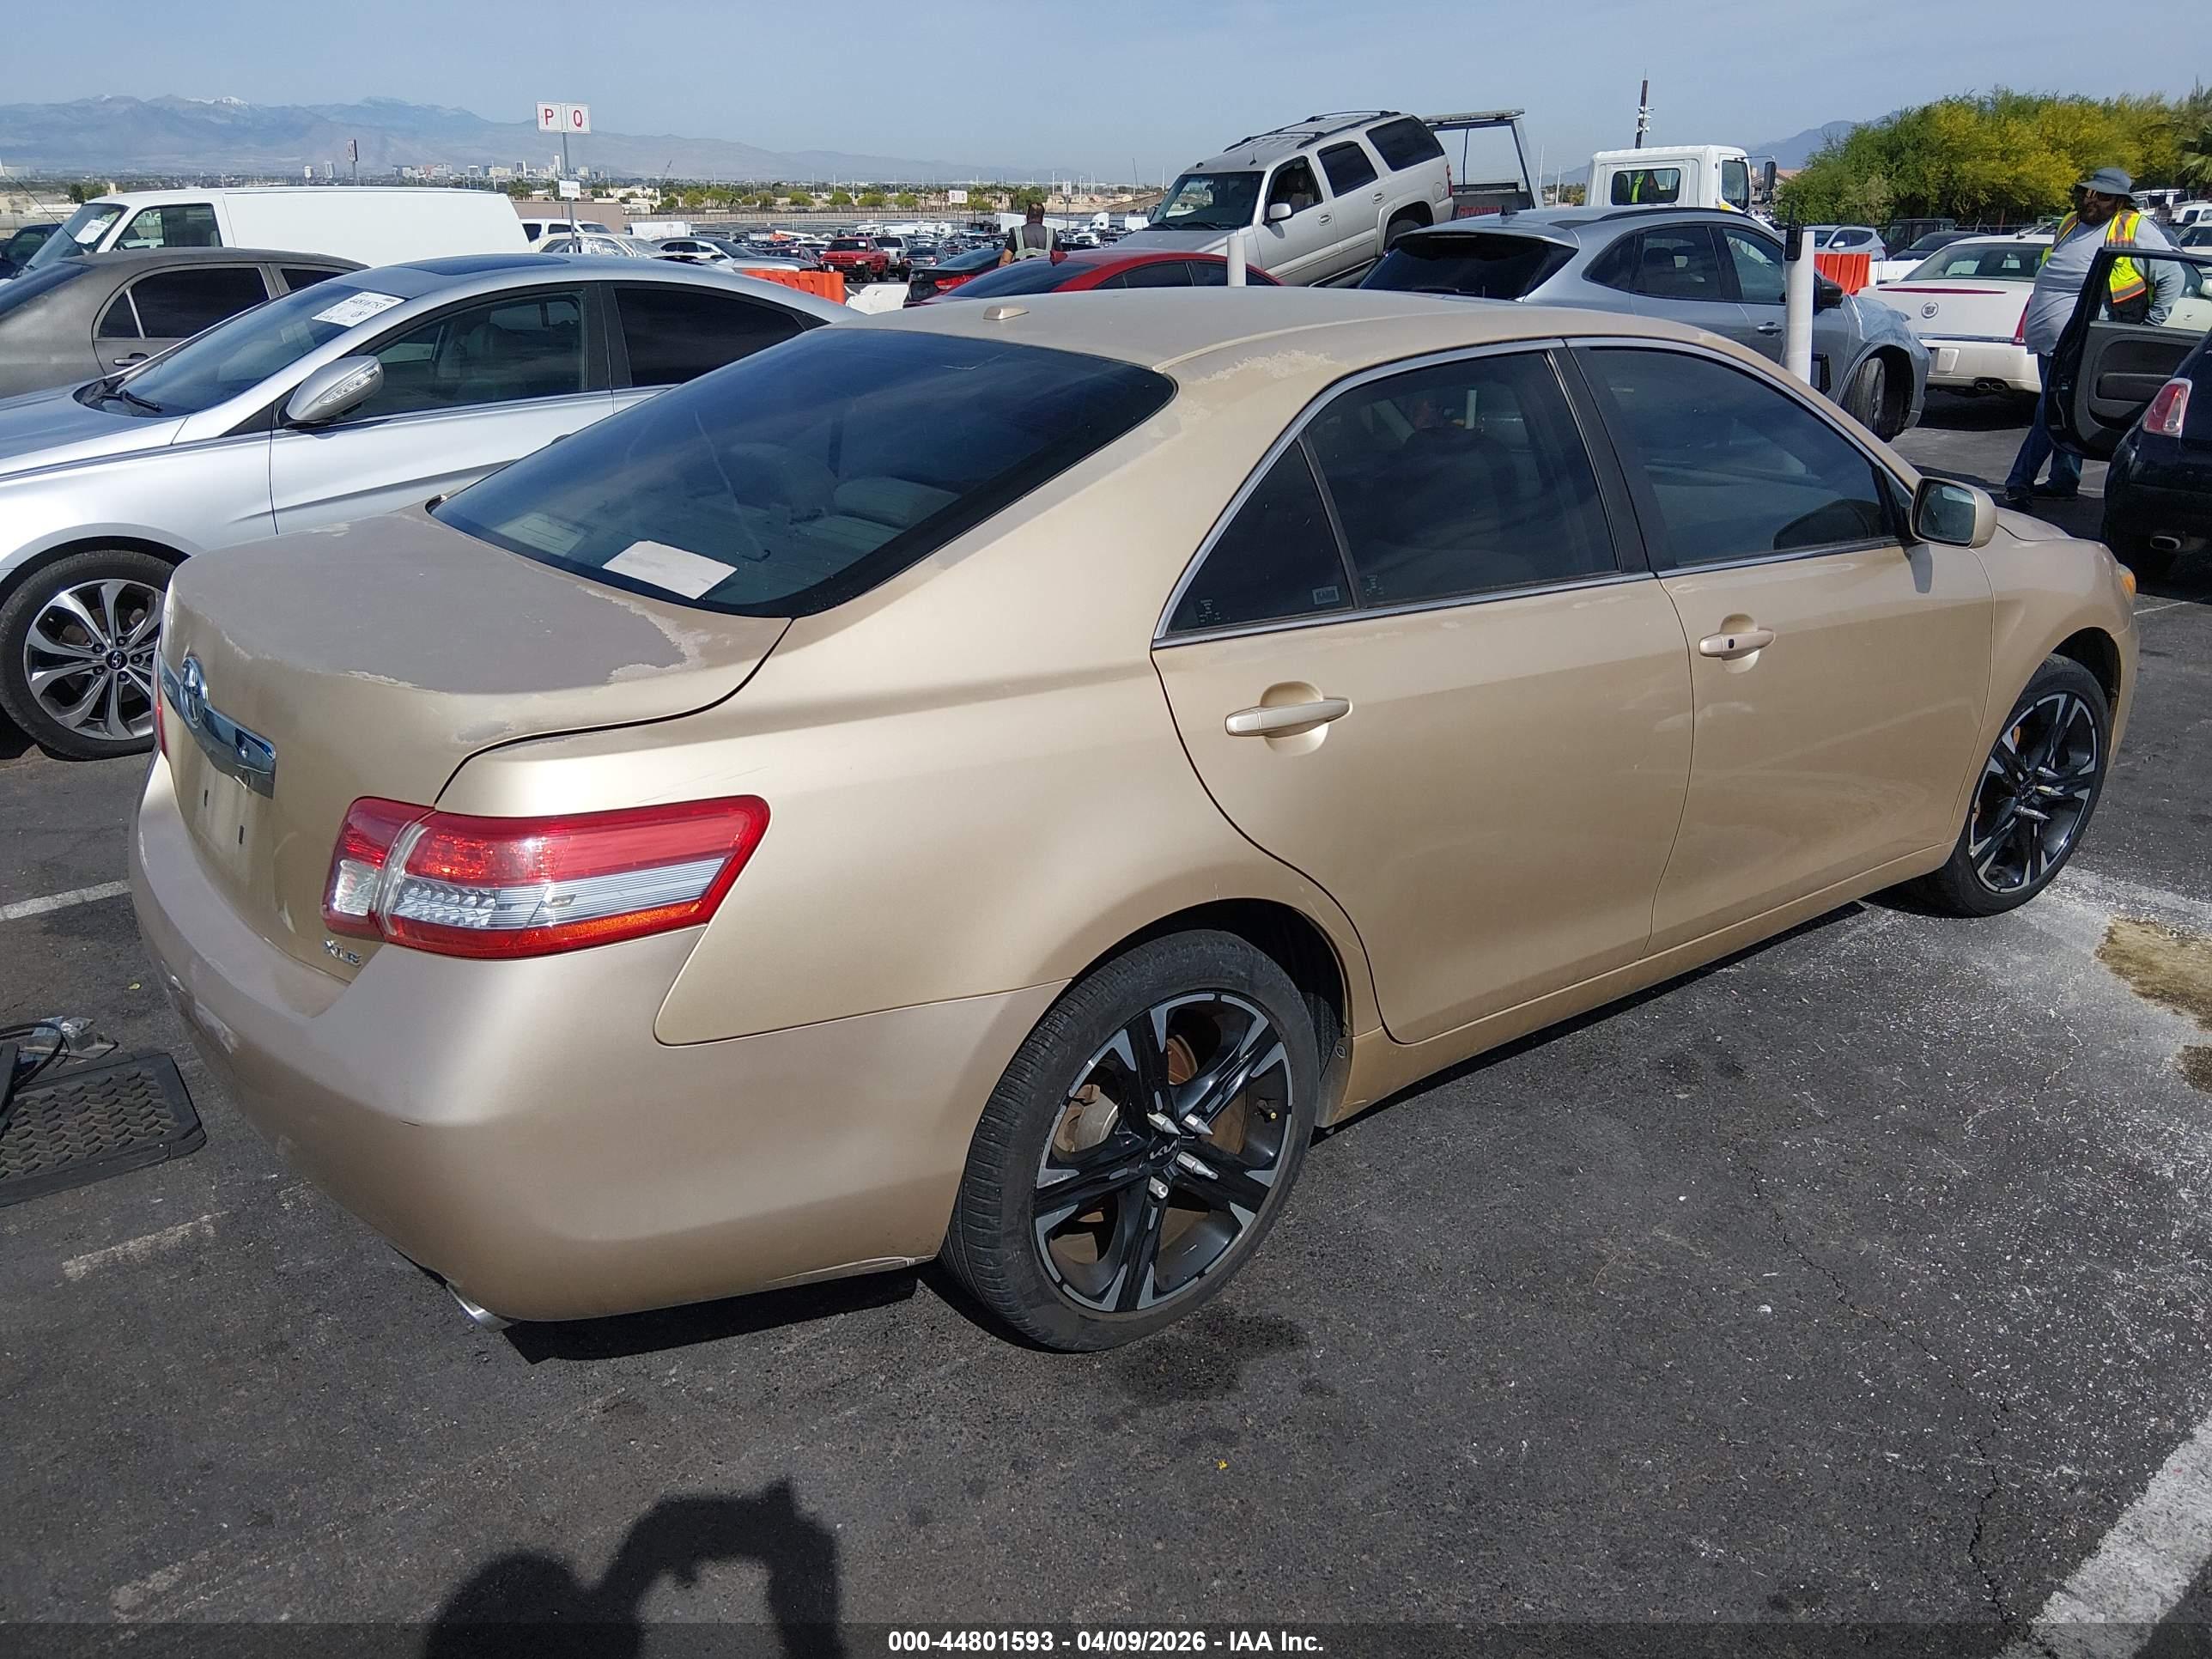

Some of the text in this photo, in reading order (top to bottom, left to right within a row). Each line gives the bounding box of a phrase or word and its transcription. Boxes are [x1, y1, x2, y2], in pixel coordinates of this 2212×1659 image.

[544, 108, 583, 128] P Q
[324, 939, 362, 967] XLE
